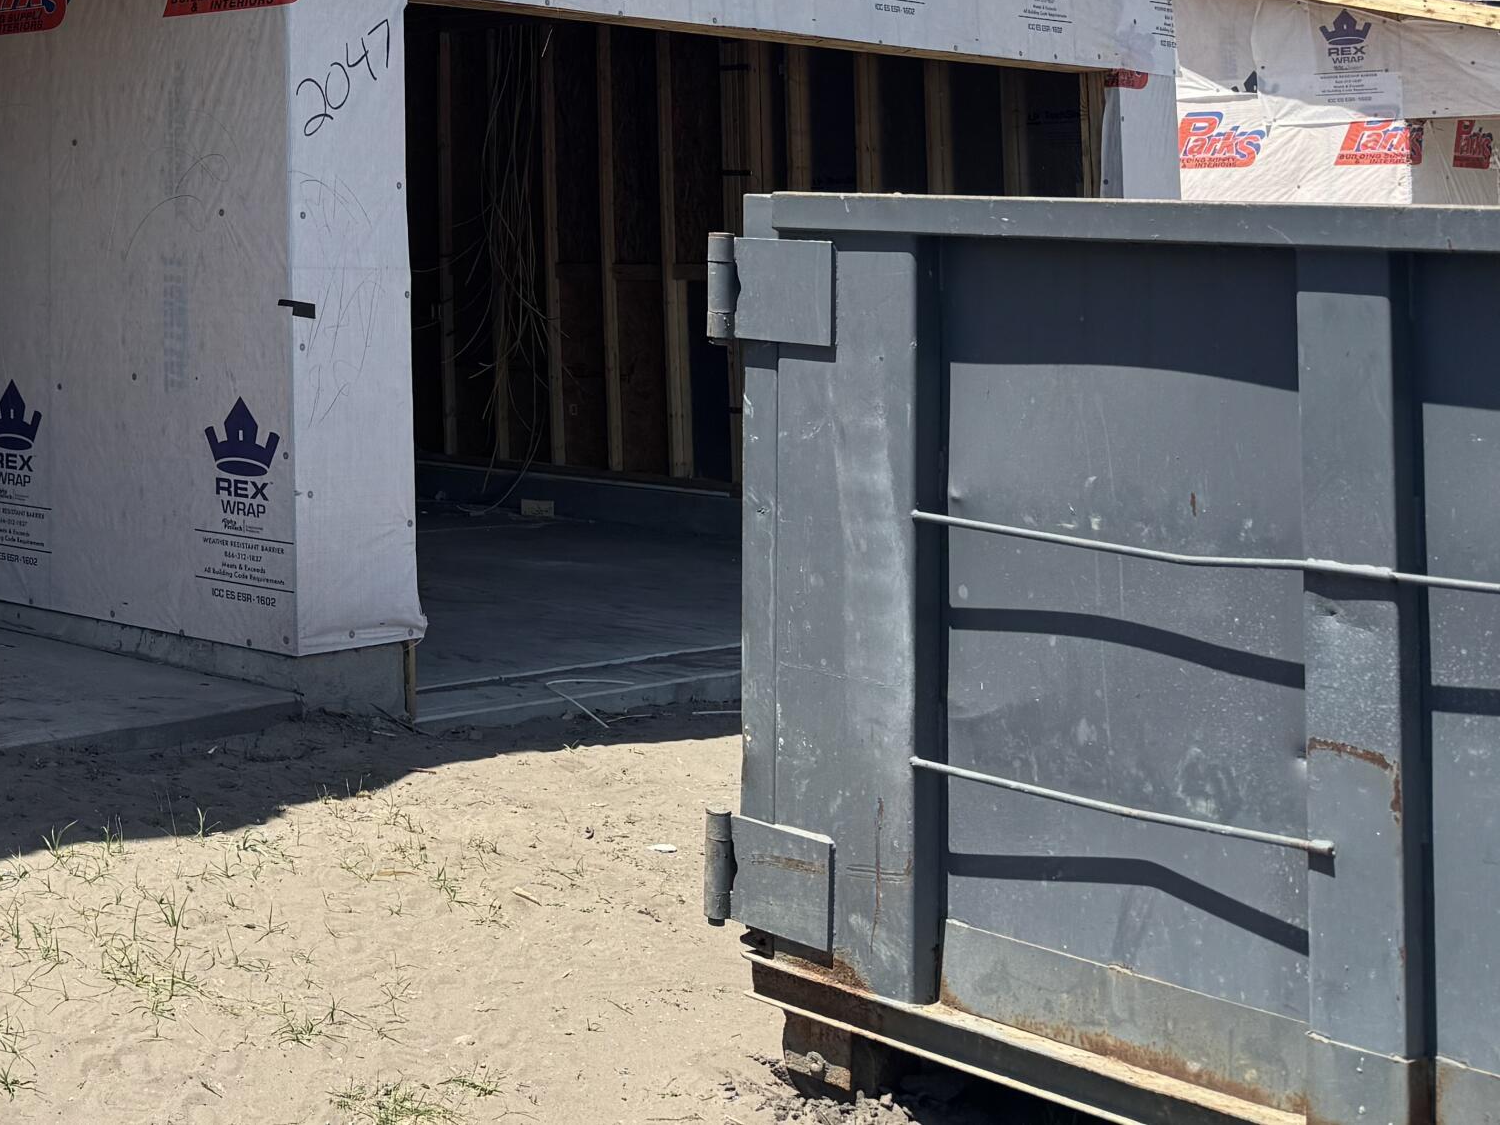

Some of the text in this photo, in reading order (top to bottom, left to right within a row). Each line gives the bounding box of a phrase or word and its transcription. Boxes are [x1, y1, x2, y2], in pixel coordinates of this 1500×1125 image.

[191, 3, 197, 12] &
[1328, 46, 1365, 56] REX
[296, 19, 390, 136] 2047
[1178, 111, 1266, 158] Parks
[216, 477, 269, 501] REX
[221, 499, 265, 517] WRAP
[203, 538, 284, 554] WEATHER RESISTANT BARRIER
[212, 588, 276, 607] ICC ES ESR-1602
